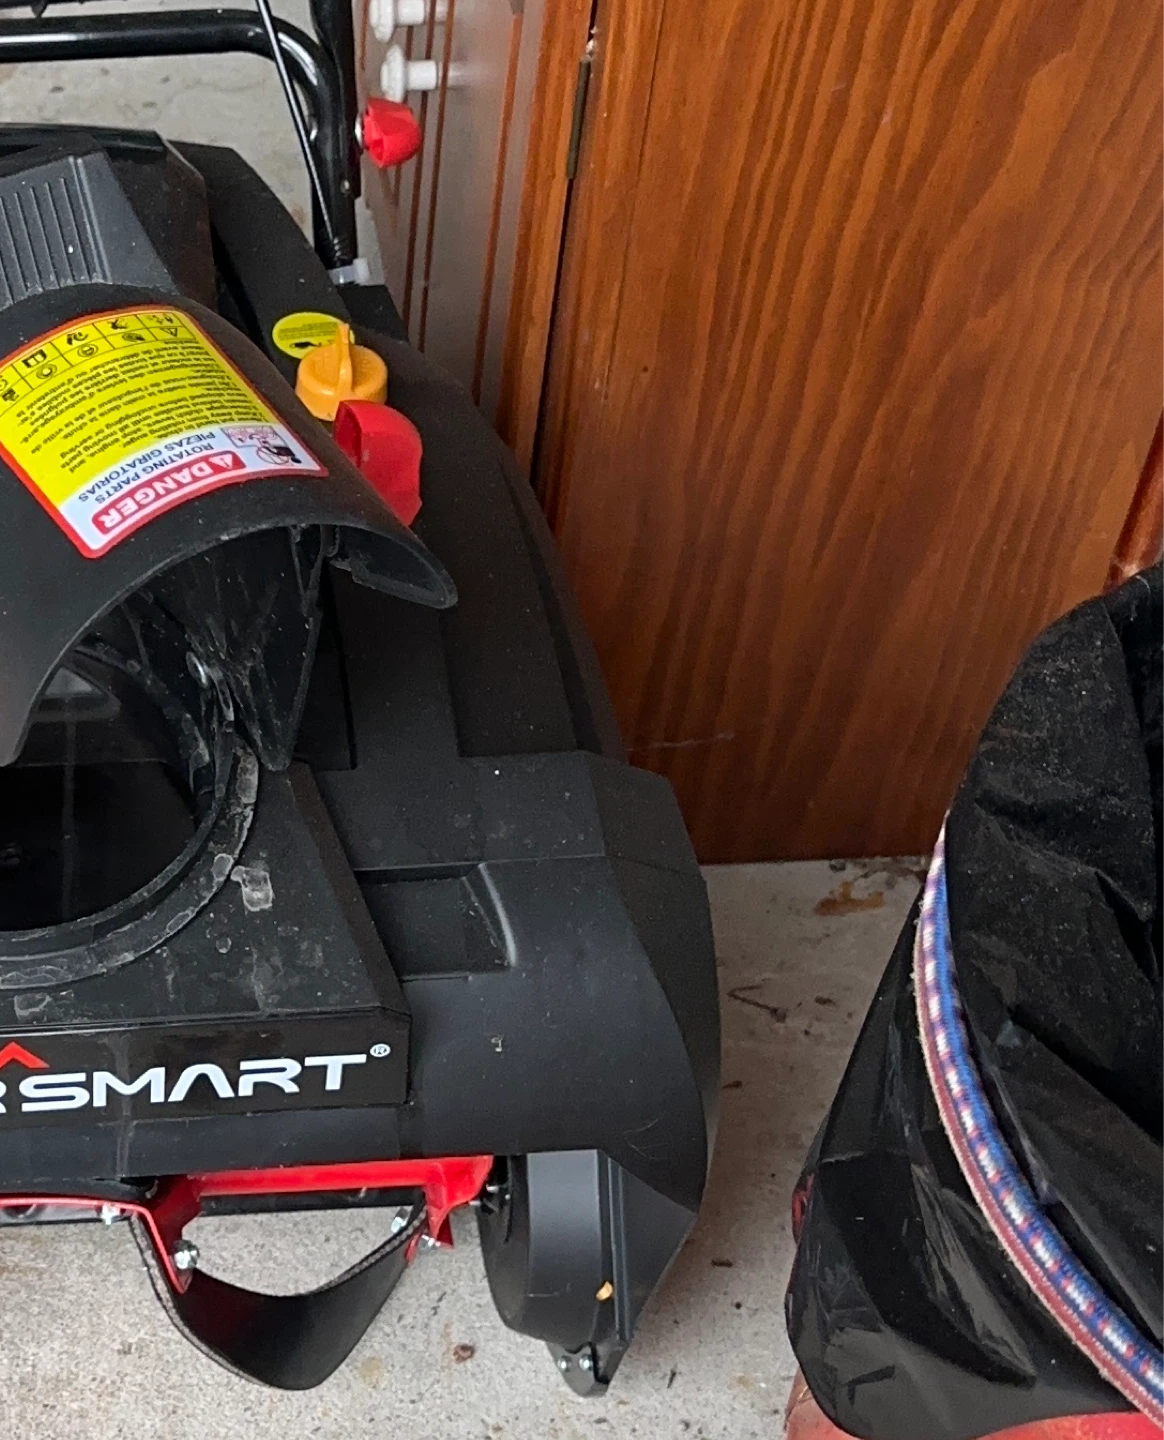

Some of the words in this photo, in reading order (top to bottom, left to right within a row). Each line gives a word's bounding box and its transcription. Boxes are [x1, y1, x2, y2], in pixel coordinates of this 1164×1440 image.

[82, 428, 117, 452] moving
[162, 431, 217, 452] PIEZAS
[59, 450, 83, 469] parts
[68, 458, 87, 473] and
[139, 442, 215, 475] ROTATING
[76, 447, 164, 503] GIRATORIAS
[93, 471, 141, 505] PARTS
[97, 460, 214, 529] DANGER
